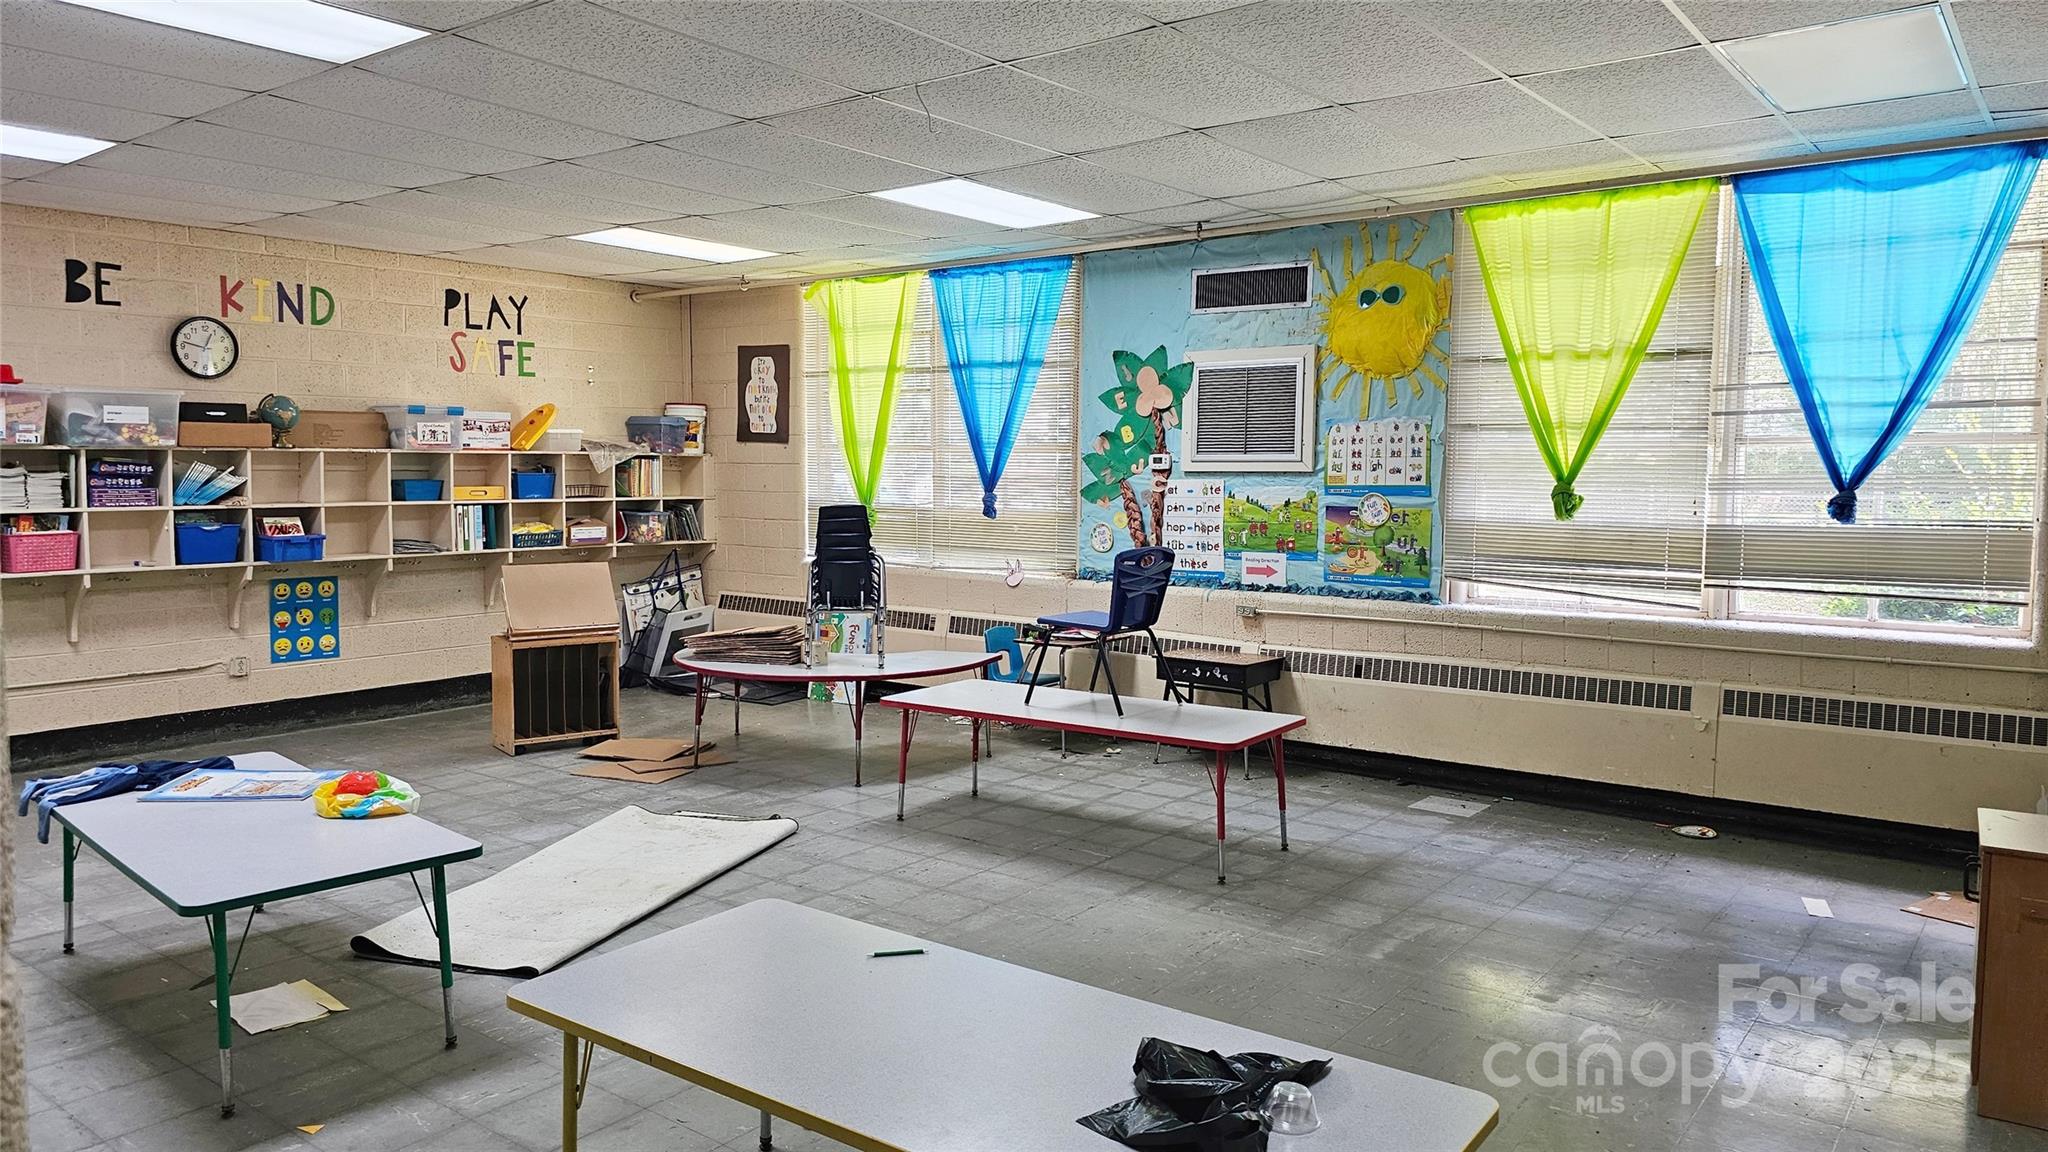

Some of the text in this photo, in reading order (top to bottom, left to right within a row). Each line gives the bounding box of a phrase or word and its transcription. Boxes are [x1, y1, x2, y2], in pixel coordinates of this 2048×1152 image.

[65, 259, 335, 325] BE KIND
[444, 288, 528, 335] PLAY
[450, 331, 536, 377] SAFE
[1115, 391, 1127, 410] E
[1121, 425, 1134, 443] B
[1131, 458, 1144, 474] J
[1167, 485, 1178, 495] at
[1166, 522, 1186, 535] hop
[1180, 559, 1208, 569] these
